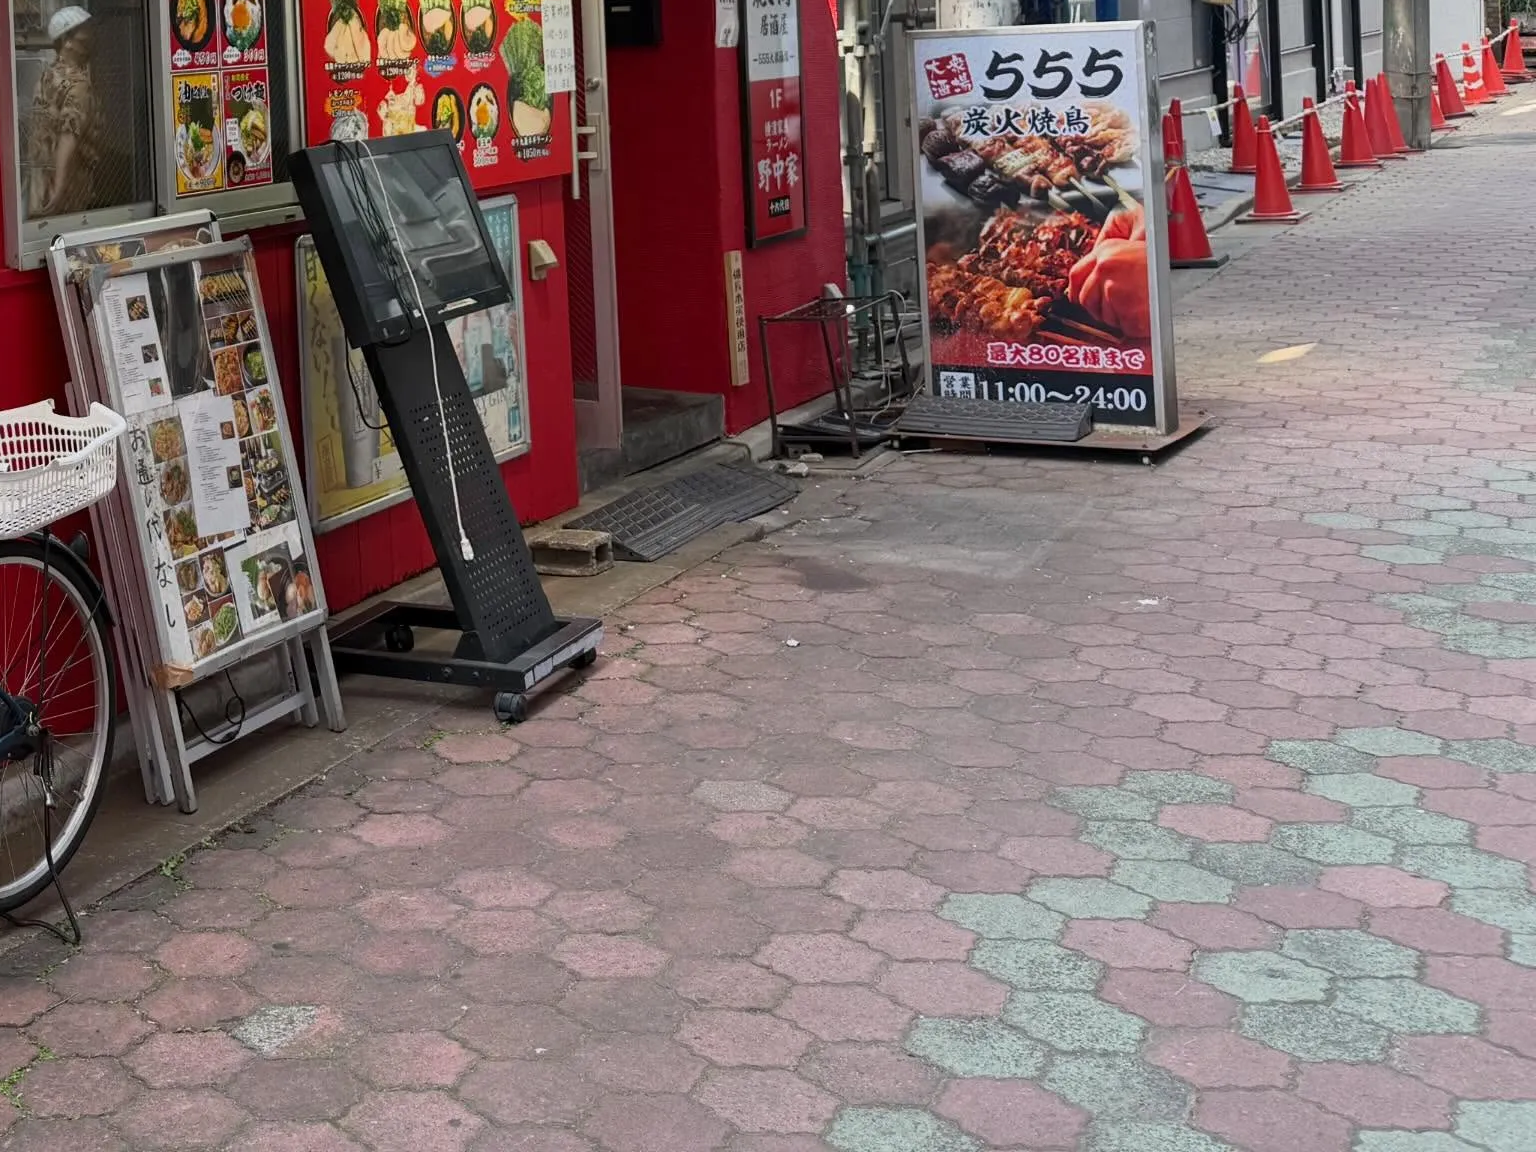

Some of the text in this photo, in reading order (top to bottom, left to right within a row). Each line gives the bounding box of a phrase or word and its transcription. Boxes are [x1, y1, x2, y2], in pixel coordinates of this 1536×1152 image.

[979, 45, 1124, 101] 555
[770, 88, 782, 109] 1F
[962, 105, 1089, 136] 炭火焼鳥
[757, 152, 799, 192] 野中家
[987, 342, 1146, 369] 最大80名様まで
